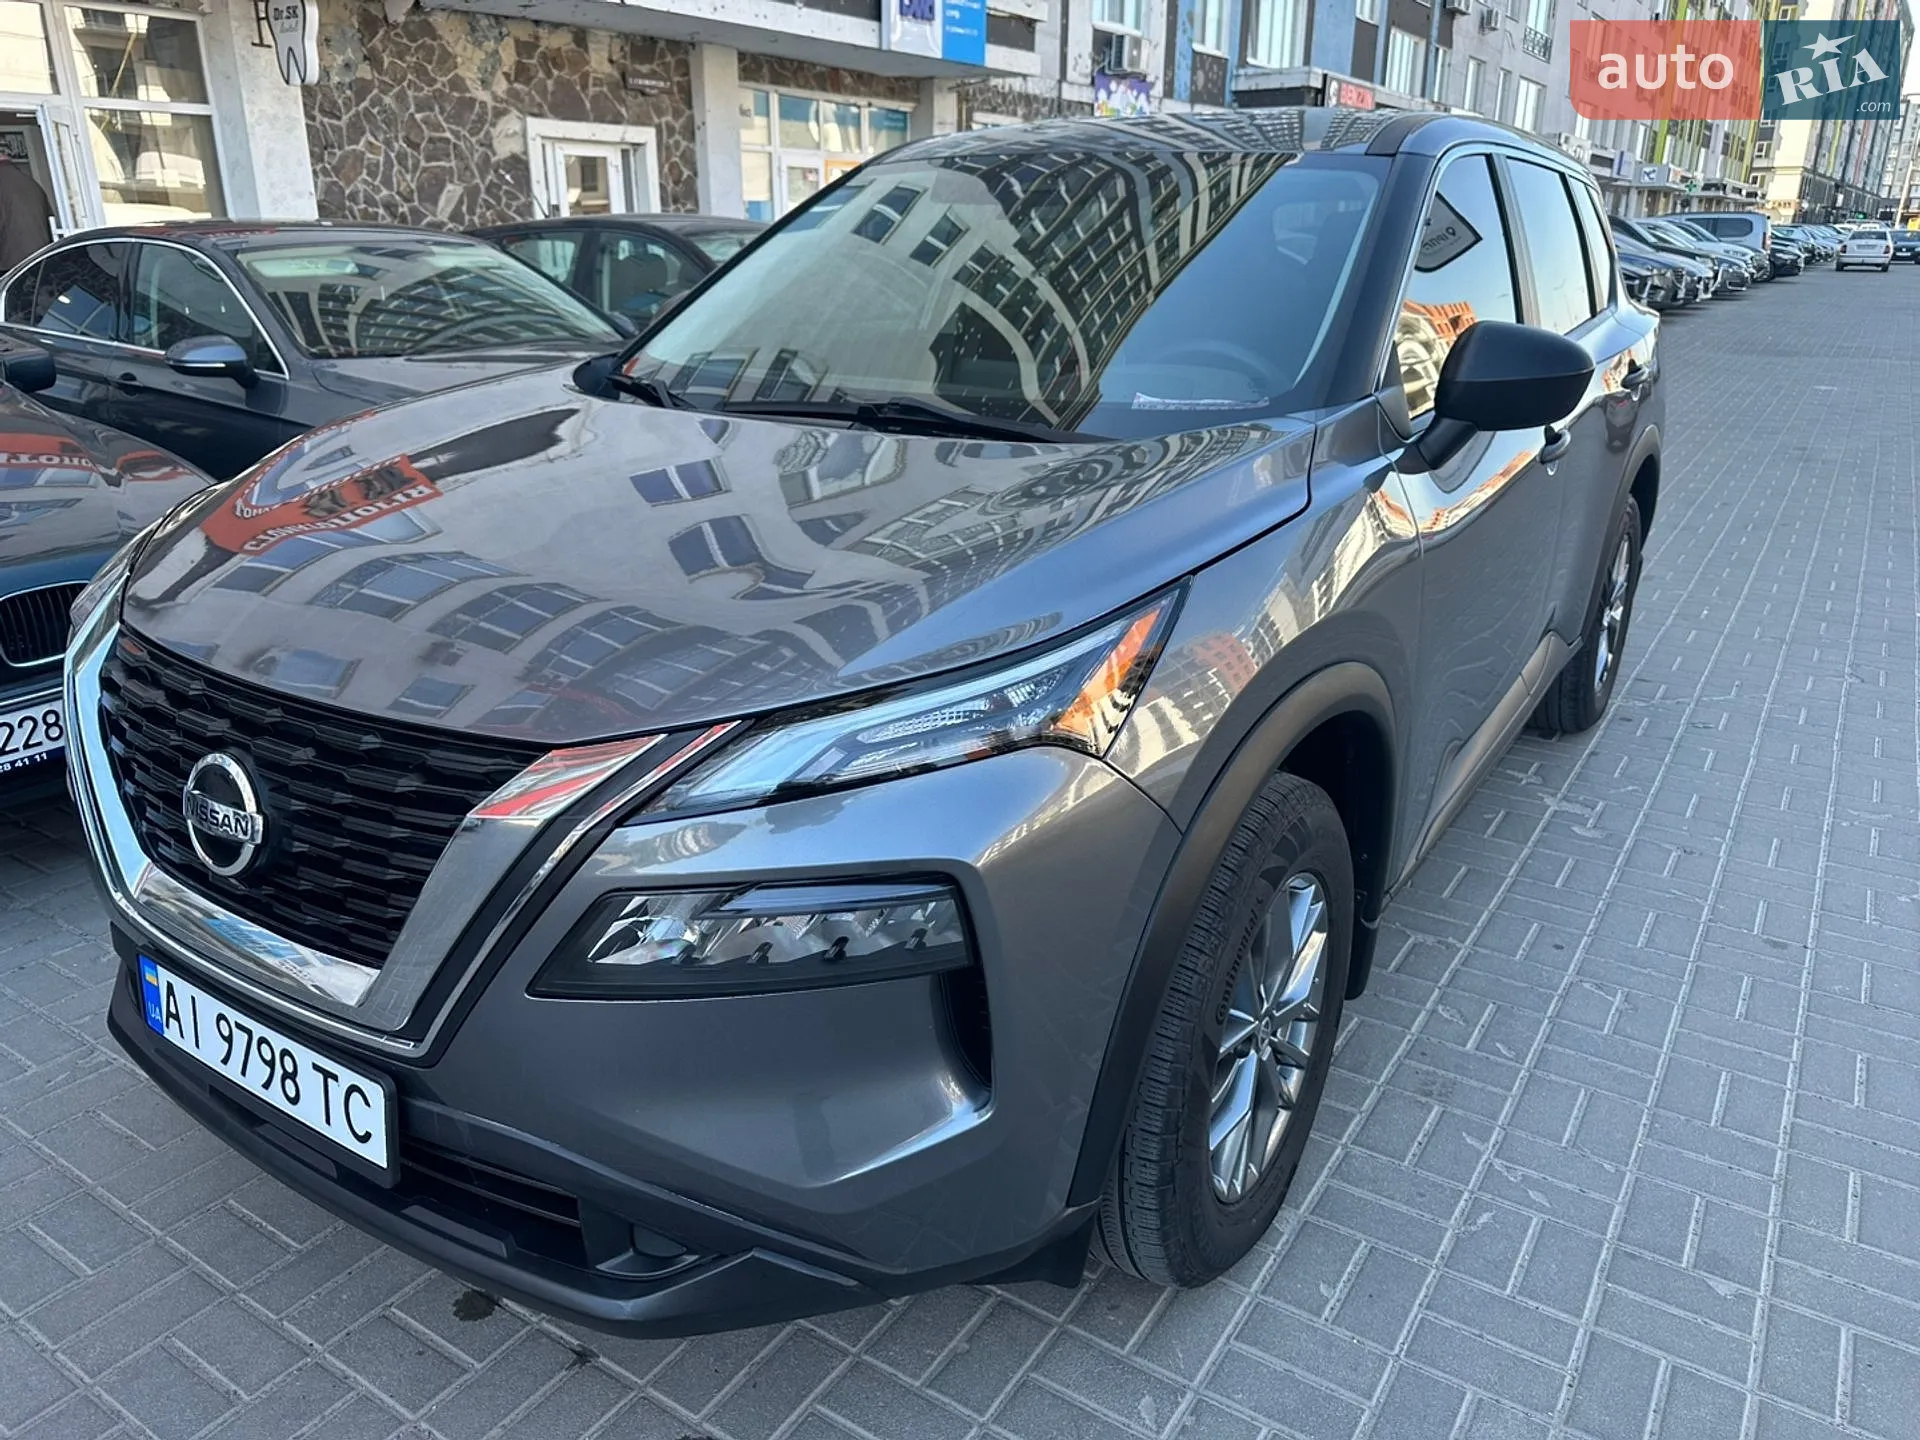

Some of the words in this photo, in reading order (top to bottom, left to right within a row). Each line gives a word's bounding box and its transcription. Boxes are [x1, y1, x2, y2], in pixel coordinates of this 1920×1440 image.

[14, 757, 29, 767] 41
[34, 752, 47, 762] 11
[185, 794, 250, 837] NISSAN
[147, 1002, 163, 1021] UA
[164, 980, 201, 1050] AI
[215, 1012, 301, 1106] 9798
[311, 1061, 373, 1144] TC
